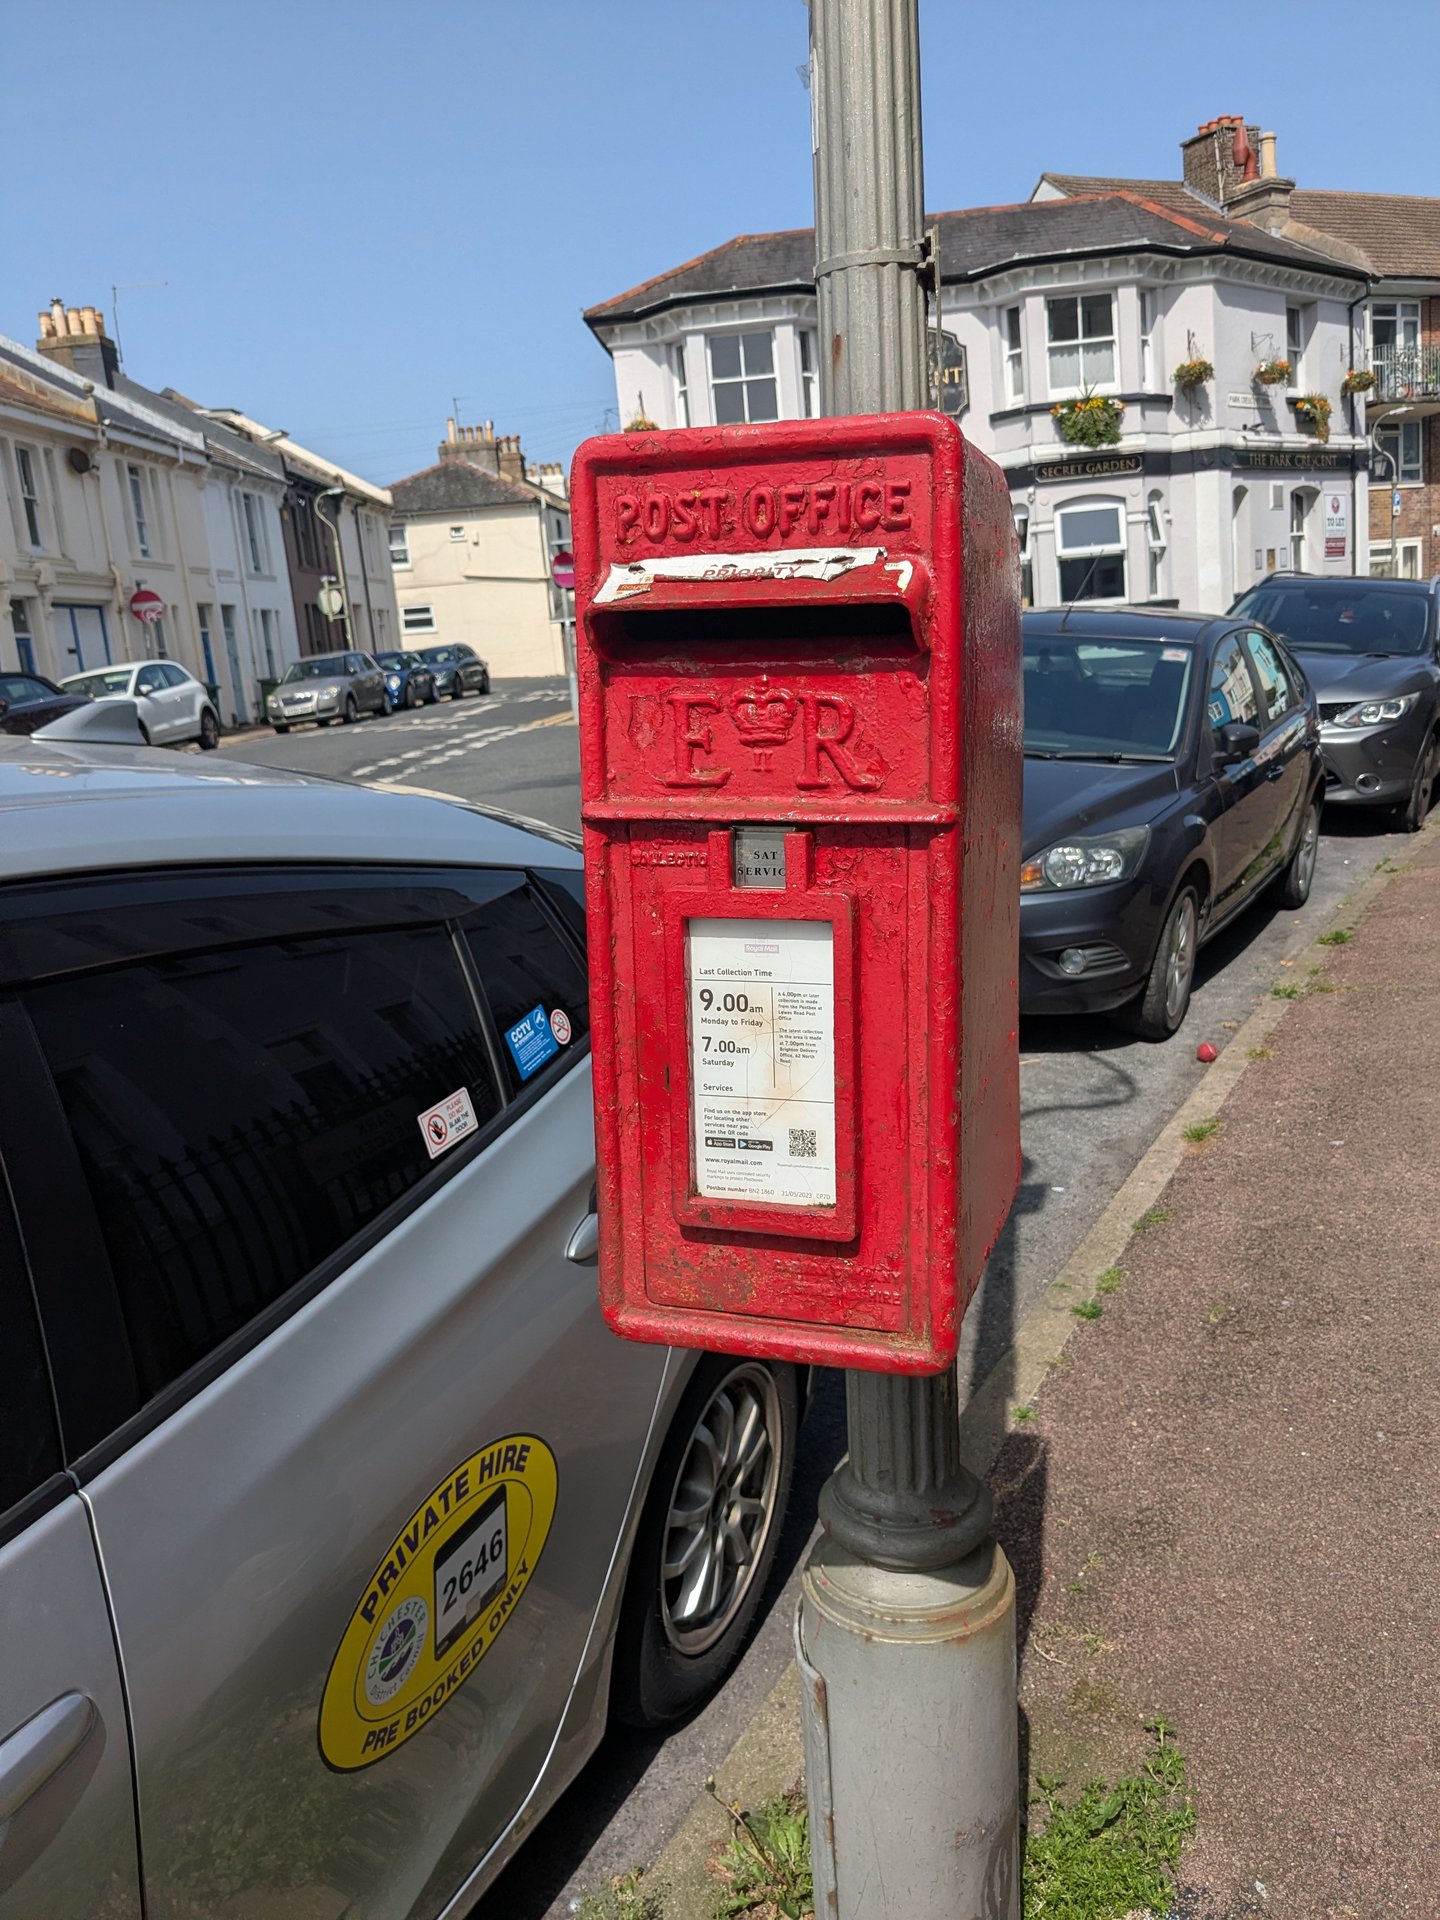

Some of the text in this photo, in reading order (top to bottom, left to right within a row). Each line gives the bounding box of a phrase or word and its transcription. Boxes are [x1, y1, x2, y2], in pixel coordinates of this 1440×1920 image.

[1249, 453, 1338, 467] THE PARK CRESCENT
[1041, 459, 1136, 478] SECRET GARDEN
[614, 479, 912, 545] POST OFFICE
[1327, 517, 1345, 527] TO LET
[702, 565, 802, 579] PRIORITY
[660, 691, 886, 792] E R
[753, 850, 779, 861] SAT
[745, 944, 778, 953] Royal Mail
[699, 967, 773, 977] Last Collection Time
[699, 988, 764, 1013] 9.00am
[701, 1017, 764, 1028] Monday to Friday
[510, 1018, 532, 1044] CCTV
[702, 1036, 750, 1054] 7.00am
[702, 1057, 735, 1068] Saturday
[703, 1083, 734, 1092] Services
[446, 1097, 462, 1111] PLEASE
[448, 1104, 465, 1120] DO NOT
[460, 1110, 470, 1120] THE
[455, 1120, 469, 1134] DOOR
[704, 1156, 763, 1166] www.royalmail.com
[706, 1183, 726, 1191] Postbox
[360, 1443, 532, 1625] PRIVATE HIRE
[442, 1528, 504, 1617] 2646
[367, 1601, 427, 1681] CHICHESTER
[360, 1557, 529, 1755] PRE BOOKED ONLY
